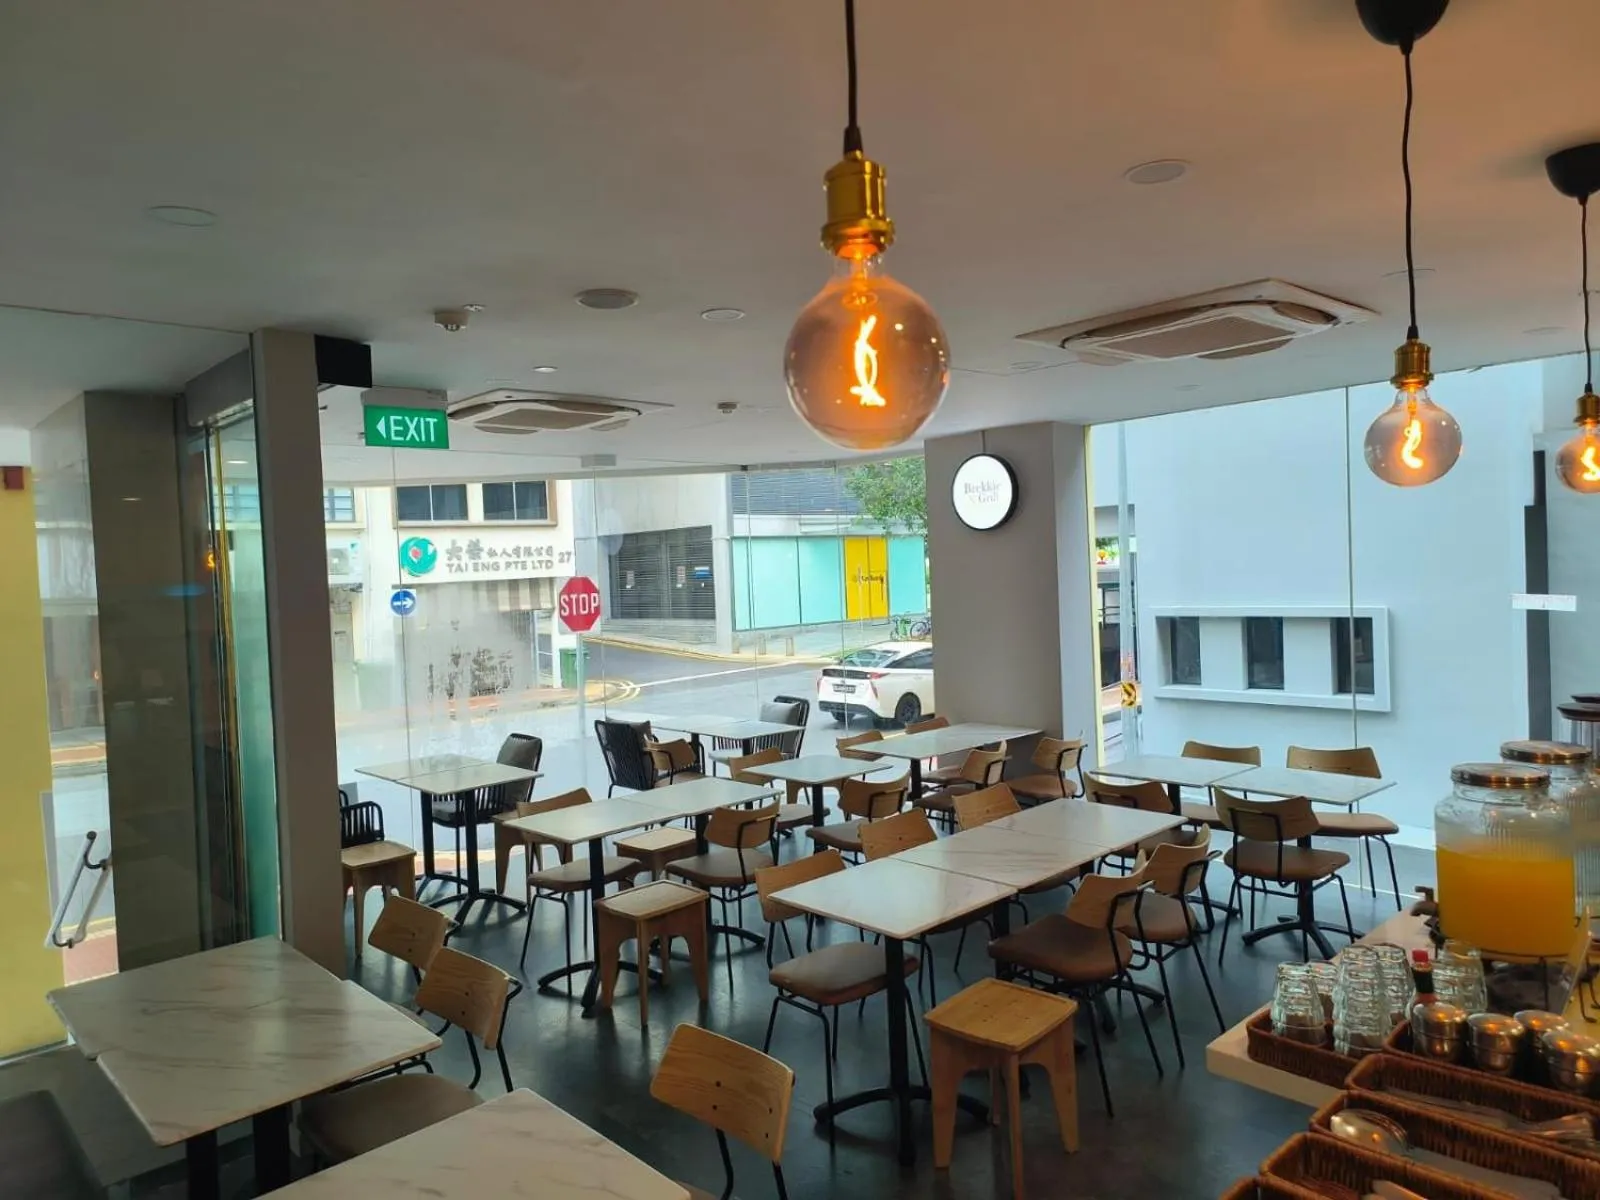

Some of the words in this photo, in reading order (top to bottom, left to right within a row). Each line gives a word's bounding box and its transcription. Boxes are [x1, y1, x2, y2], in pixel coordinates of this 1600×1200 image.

[389, 415, 438, 442] EXIT
[446, 562, 468, 573] TAI
[472, 561, 501, 573] ENG
[504, 560, 528, 571] PTE
[531, 559, 554, 570] LTD
[558, 550, 572, 563] 27
[560, 592, 599, 616] STOP
